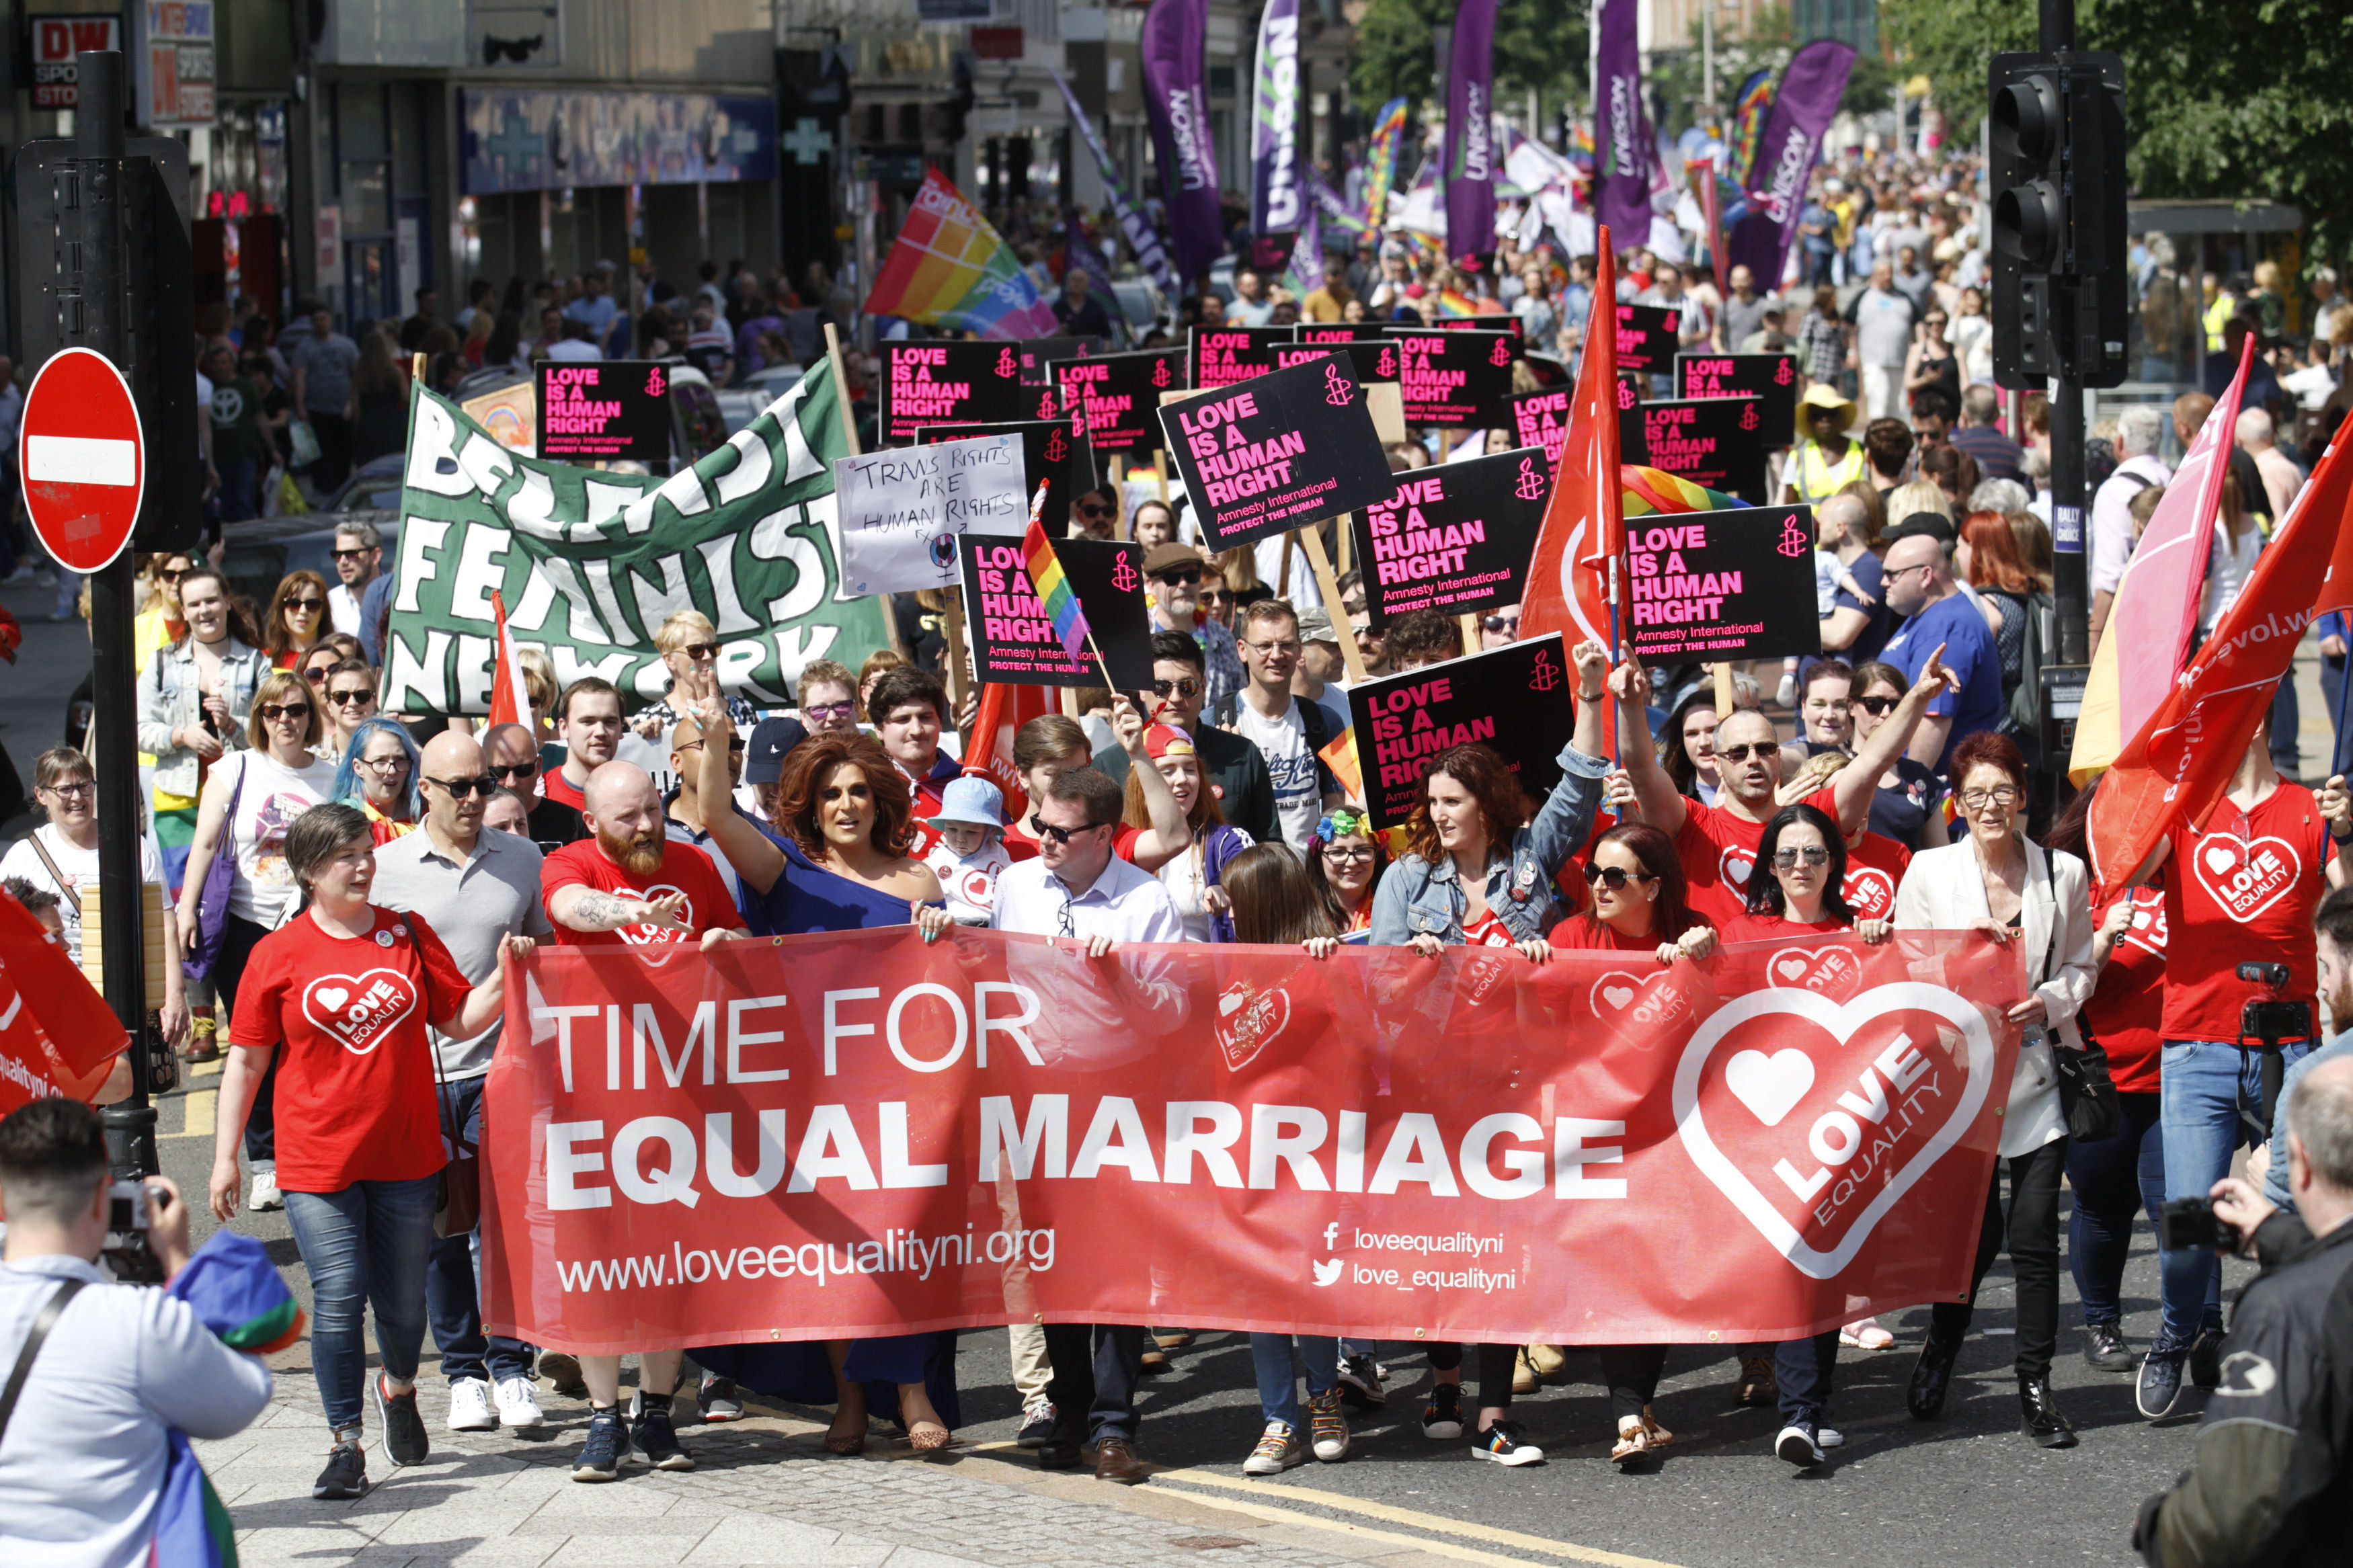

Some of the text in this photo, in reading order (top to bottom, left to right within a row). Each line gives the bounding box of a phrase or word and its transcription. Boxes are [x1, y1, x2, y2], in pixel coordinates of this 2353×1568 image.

[42, 22, 110, 60] DW
[1267, 15, 1299, 227] UNISON
[1611, 75, 1636, 176] UNISON
[1168, 89, 1205, 191] UNISON
[1200, 333, 1250, 349] LOVE
[1306, 331, 1354, 343] LOVE
[1397, 337, 1445, 354] OVE
[891, 347, 947, 365] LOVE
[1200, 349, 1236, 364] IS A
[1400, 354, 1431, 370] S A
[1685, 360, 1734, 376] LOVE
[545, 368, 600, 385] LOVE
[891, 365, 932, 382] IS A
[1059, 364, 1109, 383] LOVE
[1200, 364, 1270, 380] HUMAN
[1685, 376, 1721, 390] IS A
[546, 384, 585, 401] IS A
[891, 382, 969, 399] HUMAN
[1082, 382, 1098, 398] A
[545, 401, 621, 417] HUMAN
[891, 399, 955, 416] RIGHT
[1179, 392, 1259, 436] LOVE
[1427, 404, 1476, 413] International
[1513, 392, 1568, 417] LOVE
[1644, 408, 1696, 425] LOVE
[545, 417, 608, 434] RIGHT
[891, 418, 928, 427] Amnesty
[1517, 412, 1558, 433] IS A
[1645, 424, 1682, 440] IS A
[546, 436, 633, 445] Amnesty International
[1187, 424, 1248, 460] IS A
[1647, 437, 1716, 455] HUMAN
[854, 447, 1011, 490] TRANS RIGHTS
[1196, 430, 1306, 483] HUMAN
[919, 472, 963, 499] ARE
[1205, 460, 1291, 507] RIGHT
[864, 493, 1014, 533] HUMAN RIGHTS
[1216, 477, 1337, 524] Amnesty International
[1220, 497, 1324, 536] PROTECT THE HUMAN
[1369, 507, 1428, 538] IS A
[2057, 507, 2080, 523] RALLY
[1373, 520, 1486, 562] HUMAN
[1628, 525, 1706, 553] LOVE
[2057, 528, 2080, 542] CHOICE
[975, 546, 1027, 570] LOV
[1377, 547, 1468, 585] RIGHT
[1630, 551, 1687, 577] IS A
[978, 569, 1032, 594] IS A
[1383, 567, 1511, 602] Amnesty International
[1632, 571, 1743, 602] HUMAN
[1384, 586, 1494, 616] PROTECT THE HUMAN
[1633, 596, 1724, 626] RIGHT
[1635, 622, 1764, 642] Amnesty International
[989, 646, 1035, 661] Amnesty
[1635, 638, 1745, 655] PROTECT THE HUMAN
[989, 661, 1089, 673] PROTECT THE HUMN
[1368, 677, 1453, 719] LOVE
[1372, 708, 1435, 742] IS A
[1375, 715, 1495, 765] HUMAN
[1385, 803, 1415, 817] PROT
[2219, 849, 2280, 902] LOVE
[2233, 865, 2288, 913] EQUALITY
[1806, 954, 1845, 993] OVE
[335, 979, 395, 1035] LOVE
[1633, 983, 1677, 1022] OVE
[351, 990, 407, 1044] EQUALITY
[533, 981, 1045, 1093] TIME FOR
[1772, 1032, 1933, 1204] LOVE
[546, 1093, 1628, 1210] EQUAL MARRIAGE
[1814, 1071, 1942, 1228] EQUALITY
[1355, 1227, 1504, 1259] loveequalityni
[556, 1223, 1055, 1293] www.loveequalityni.org
[1353, 1262, 1516, 1295] love_equalityni
